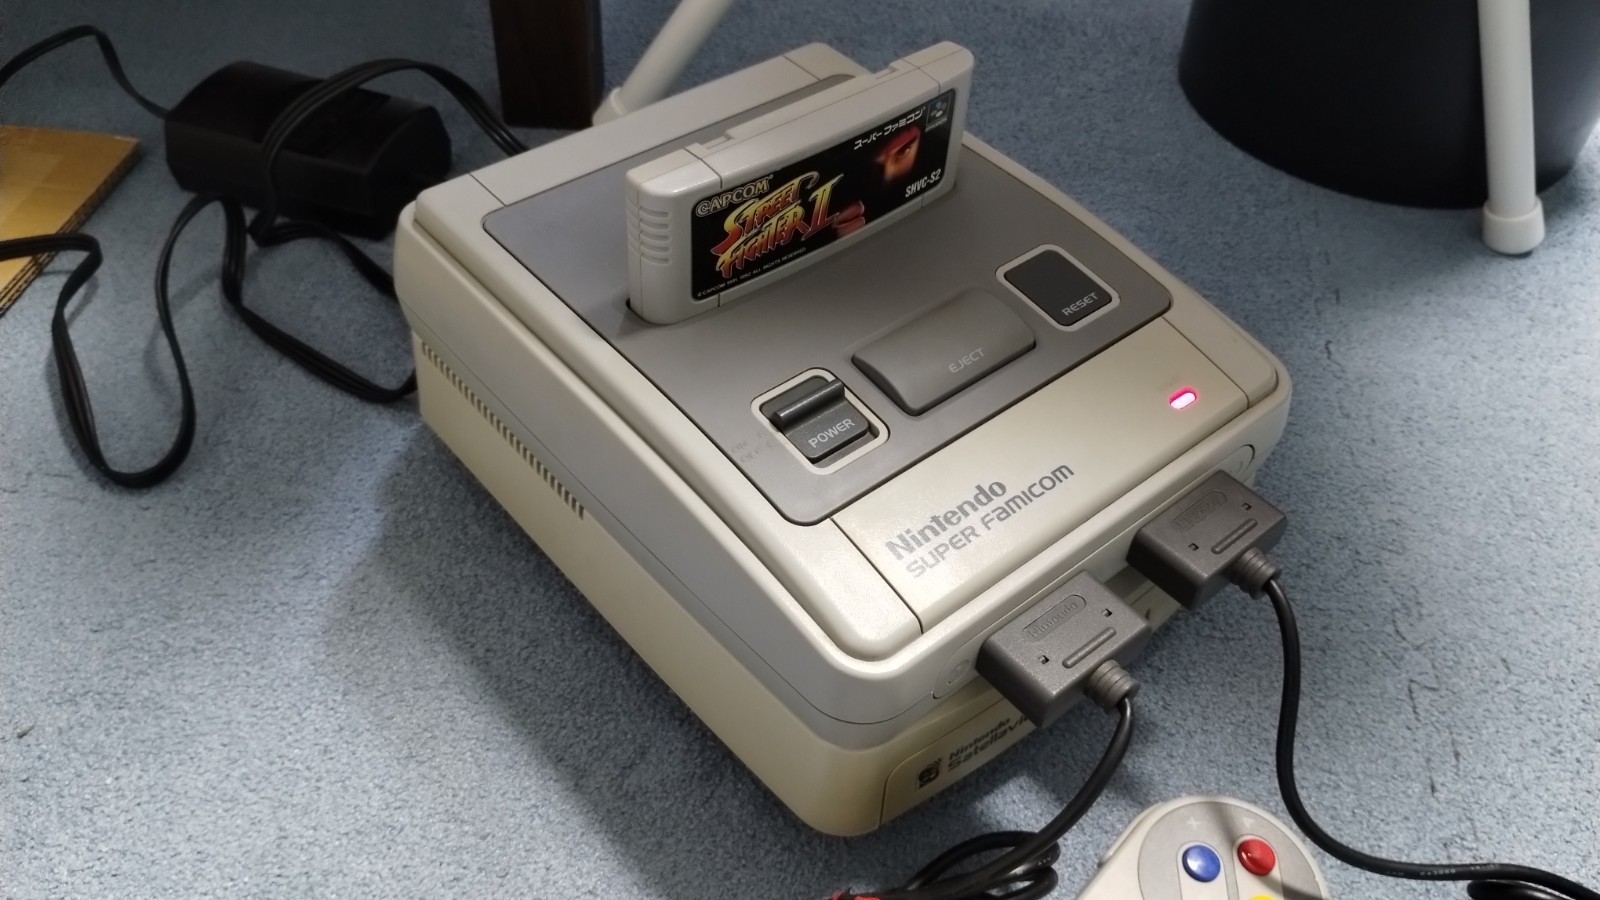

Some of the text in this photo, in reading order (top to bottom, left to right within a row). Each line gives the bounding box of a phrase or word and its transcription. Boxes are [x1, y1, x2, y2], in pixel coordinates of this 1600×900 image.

[696, 178, 770, 216] CAPCOM
[905, 168, 942, 198] SHVC-S2
[710, 171, 820, 256] STREET
[715, 200, 812, 279] FIGHTER
[1061, 292, 1100, 317] RESET
[948, 347, 985, 374] EJECT
[808, 418, 856, 449] POWER
[885, 481, 1007, 561] Nintendo
[906, 525, 981, 579] SUPER
[949, 717, 1011, 760] Nintendo
